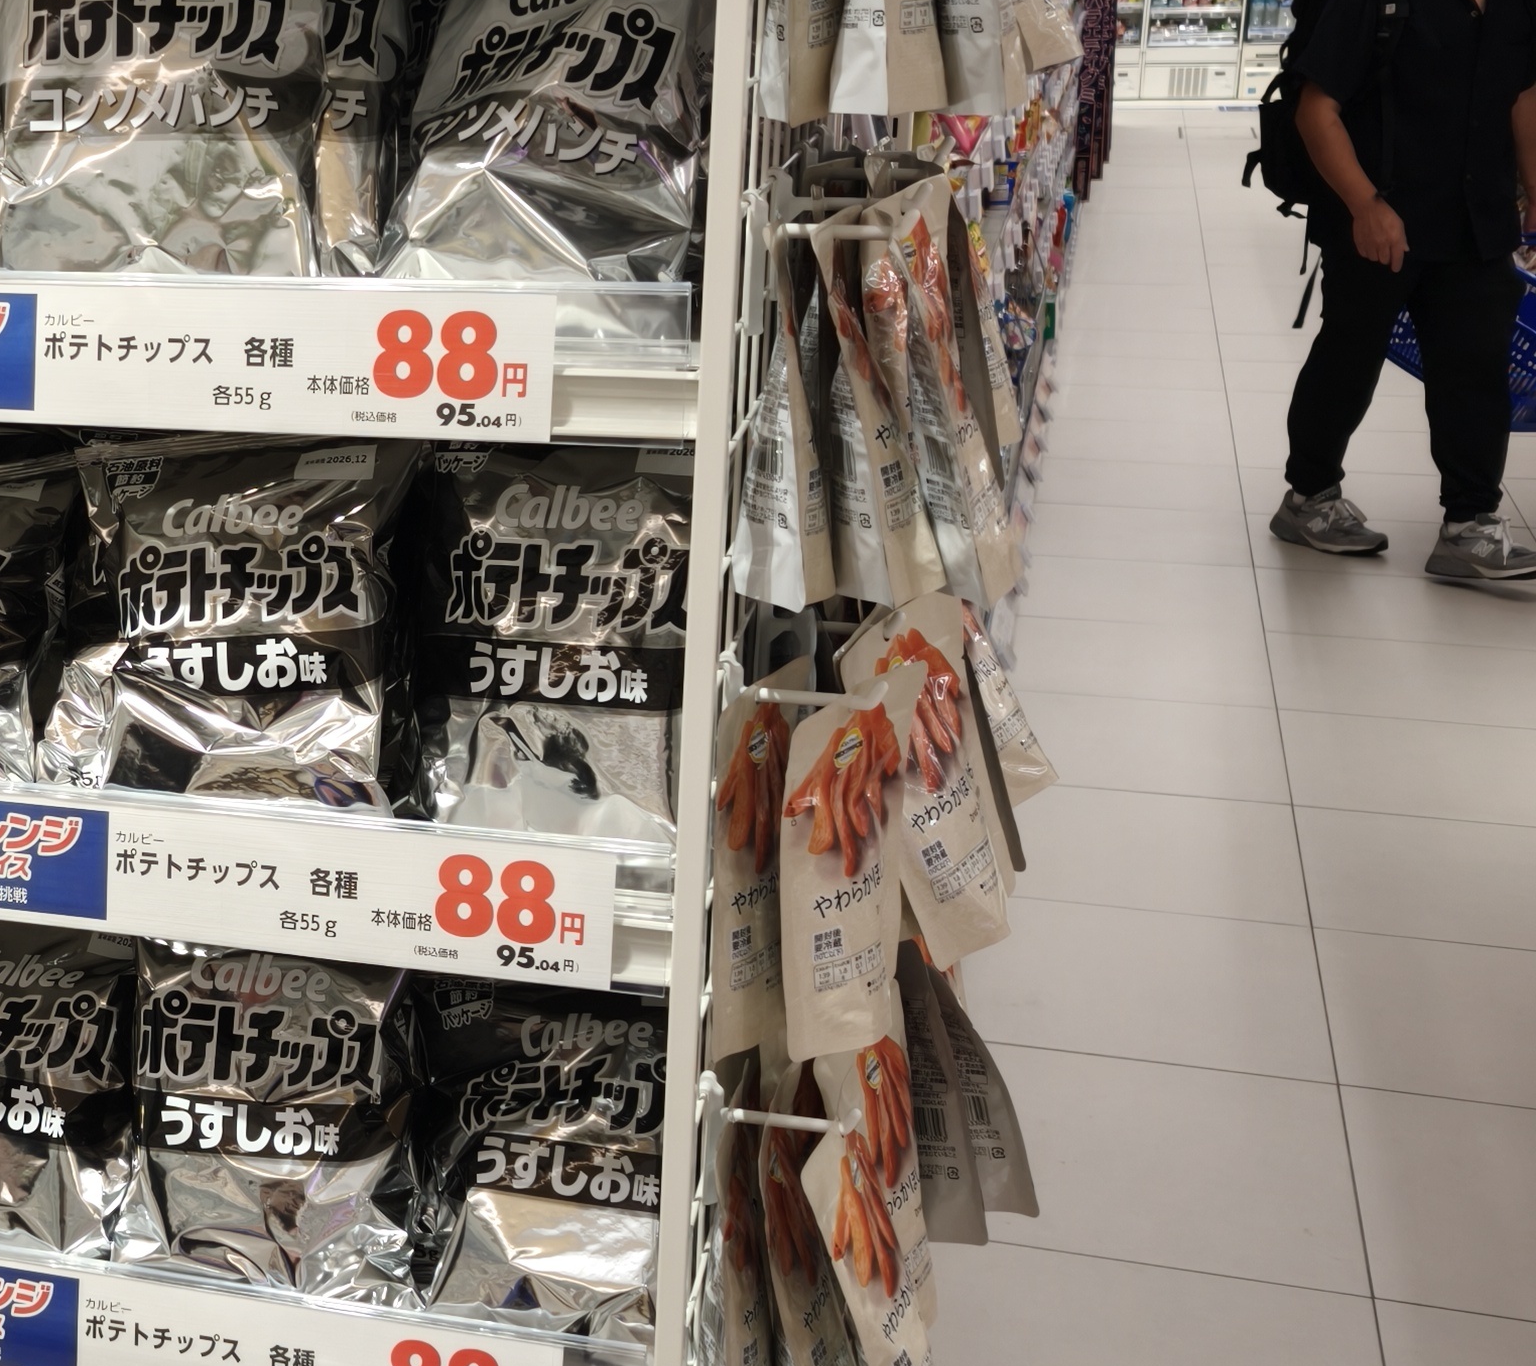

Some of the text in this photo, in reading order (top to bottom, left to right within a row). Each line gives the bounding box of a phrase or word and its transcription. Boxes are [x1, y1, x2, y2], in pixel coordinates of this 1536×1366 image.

[30, 82, 279, 132] コンソメパンチ
[44, 313, 95, 327] カルビー
[43, 330, 295, 369] ポテトチップス 各種
[306, 374, 370, 396] 本体価格
[495, 483, 646, 532] Calbee
[118, 533, 365, 639] ポテトチップス
[115, 830, 165, 846] カルビー
[115, 847, 359, 900] ポテトチップス 各種
[370, 907, 433, 933] 本体価格
[137, 987, 382, 1103] ポテトチップス
[85, 1297, 132, 1314] カルビー
[84, 1314, 242, 1364] ポテトチップス
